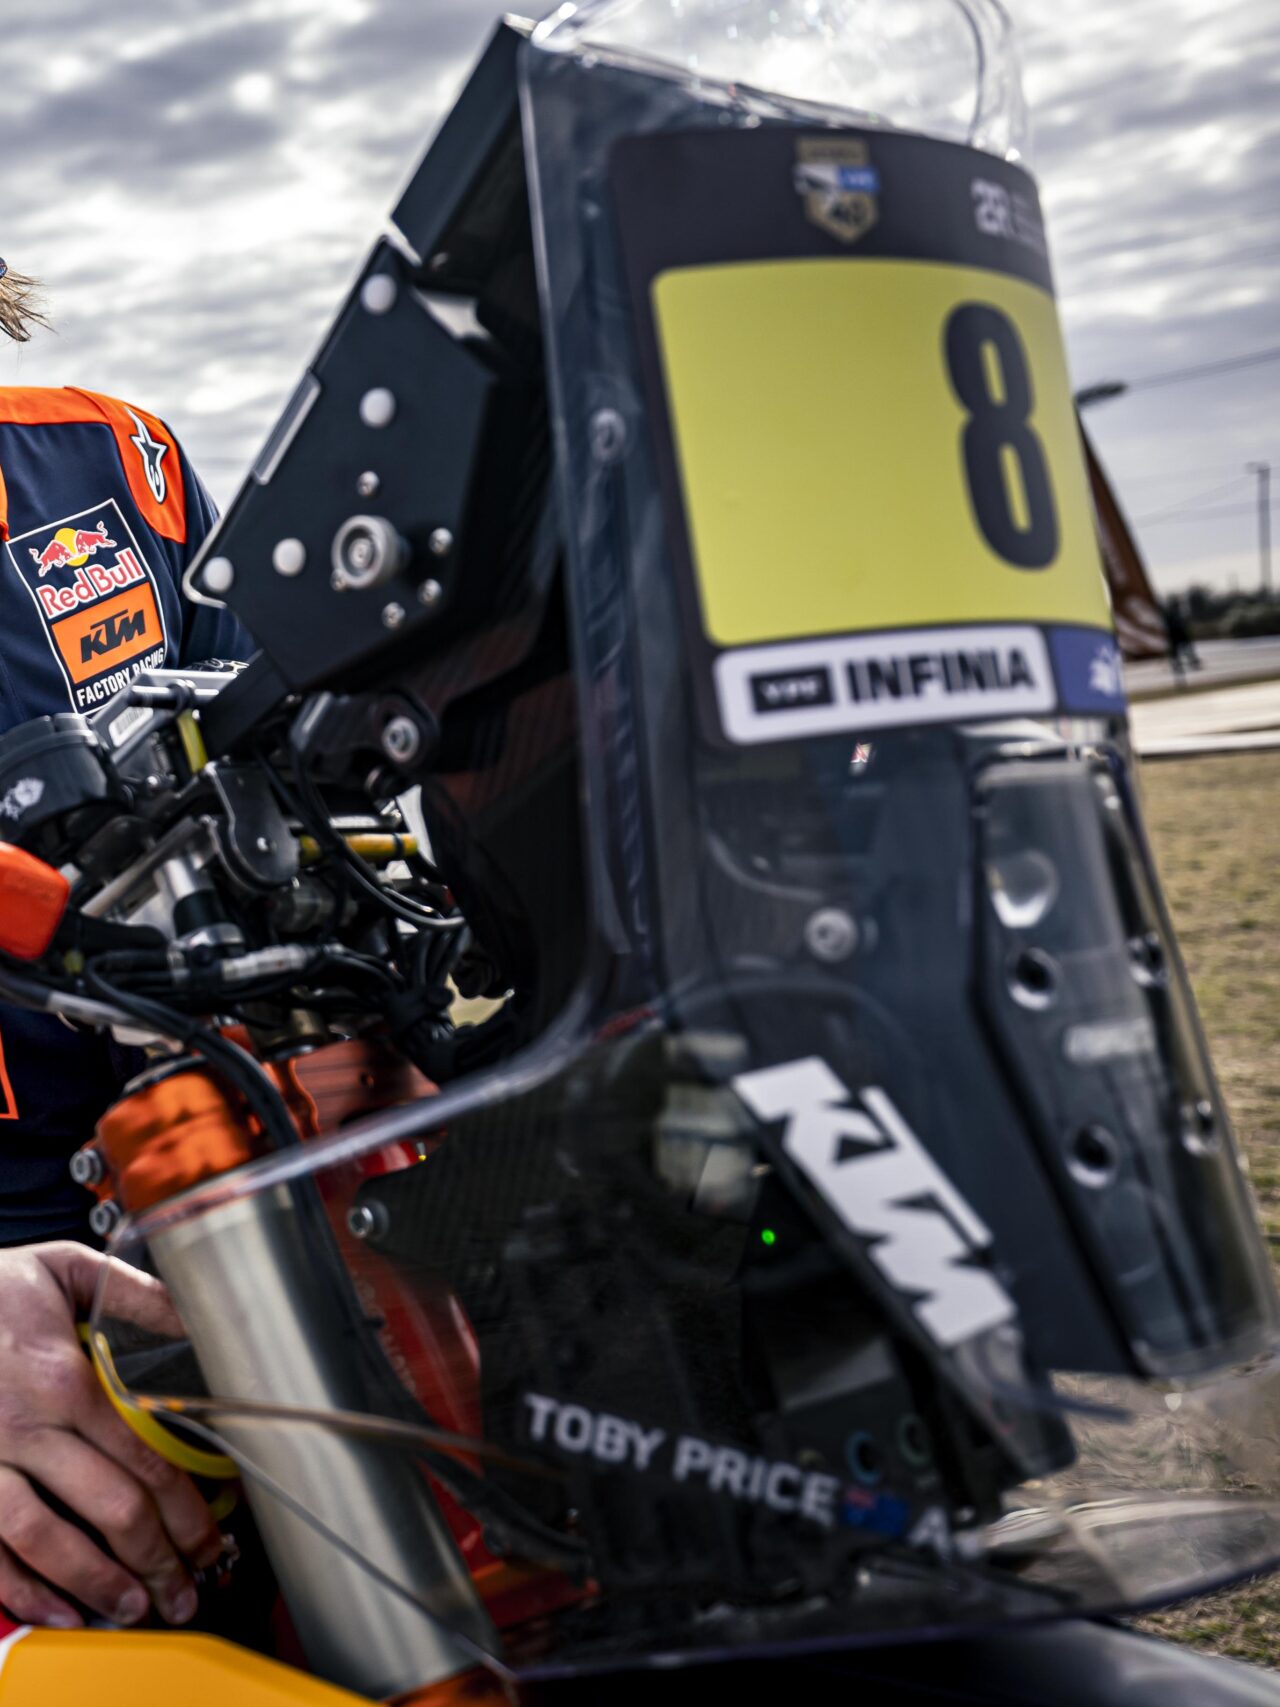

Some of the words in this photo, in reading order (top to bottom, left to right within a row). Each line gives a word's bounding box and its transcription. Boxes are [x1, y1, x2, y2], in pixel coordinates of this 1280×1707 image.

[942, 299, 1061, 572] 8
[35, 566, 99, 620] Red
[84, 547, 146, 597] Bull
[80, 609, 146, 663] KTM
[76, 667, 131, 707] FACTORY
[845, 646, 1036, 705] INFINIA
[731, 1055, 1017, 1348] KTM
[523, 1393, 665, 1471] TOBY
[672, 1435, 841, 1528] PRICE
